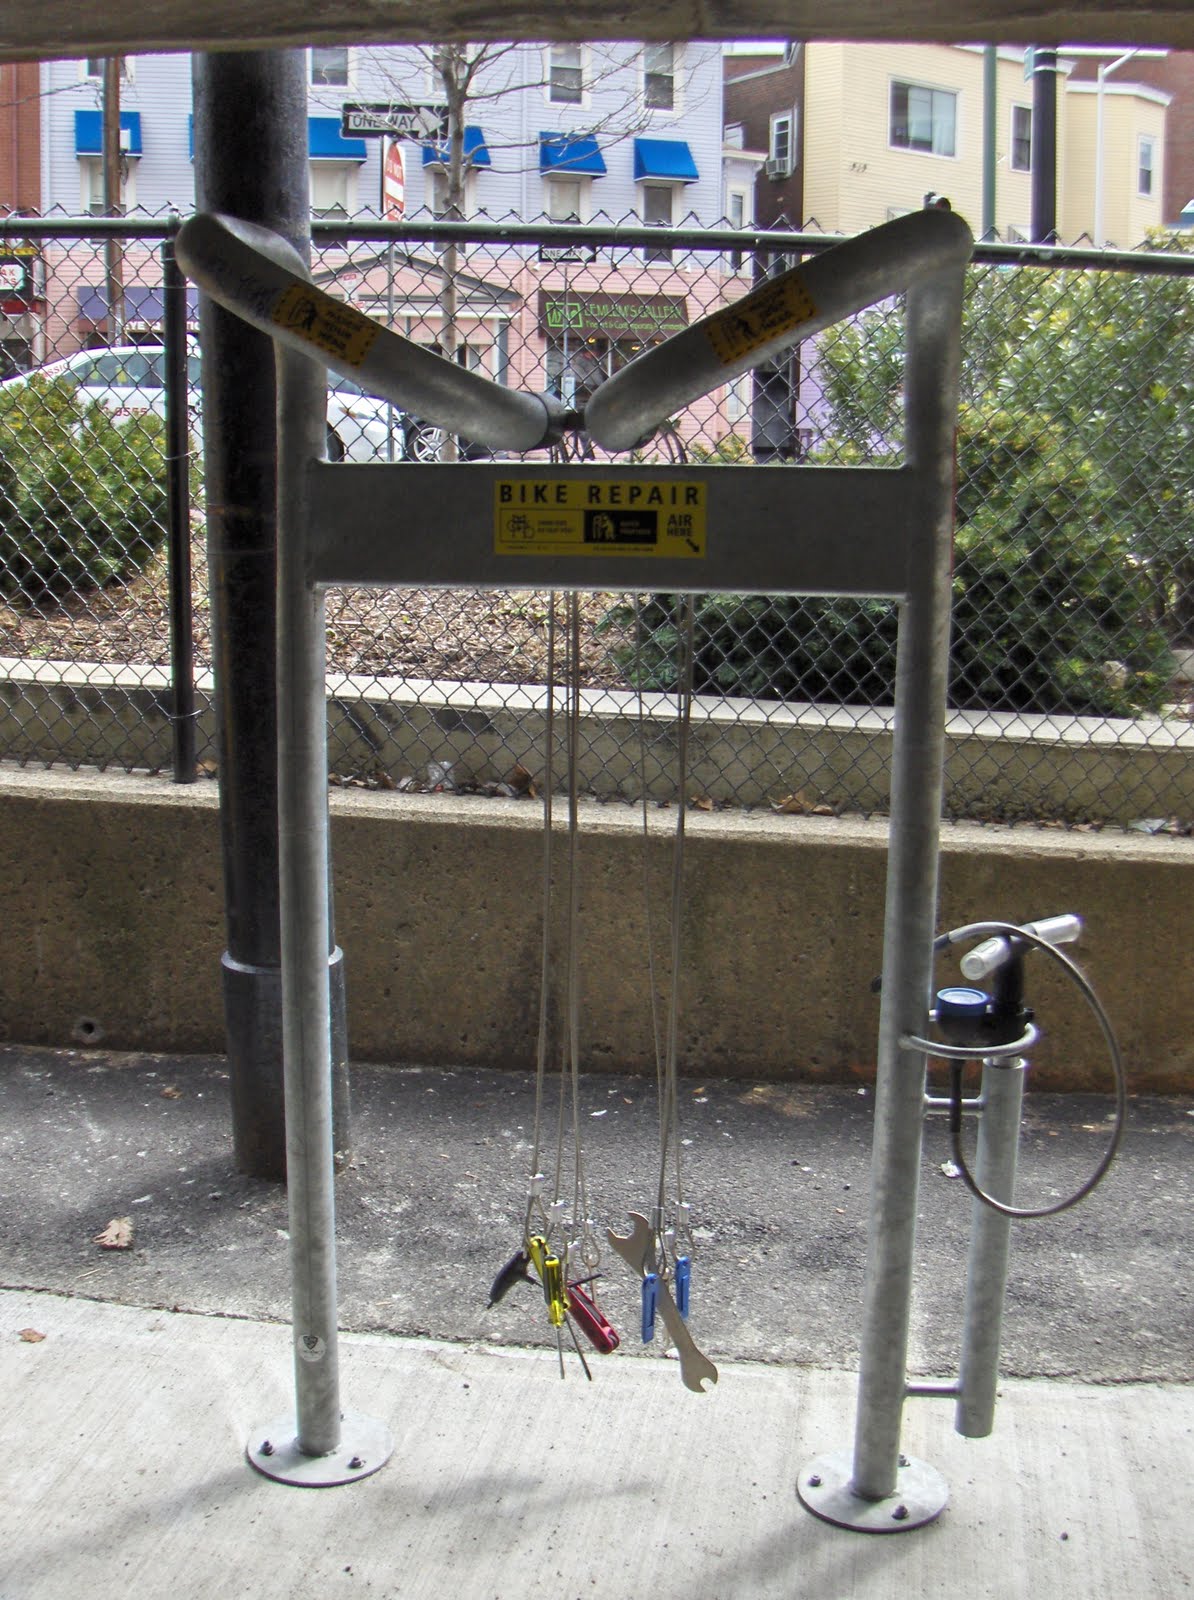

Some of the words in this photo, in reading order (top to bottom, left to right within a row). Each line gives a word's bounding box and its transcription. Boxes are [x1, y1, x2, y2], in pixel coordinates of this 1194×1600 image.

[353, 114, 380, 128] ONE
[388, 115, 417, 129] WAY
[544, 249, 561, 258] ONE
[500, 484, 568, 504] BIKE
[588, 485, 699, 505] REPAIR
[667, 514, 693, 528] AIR
[666, 526, 693, 538] HERE
